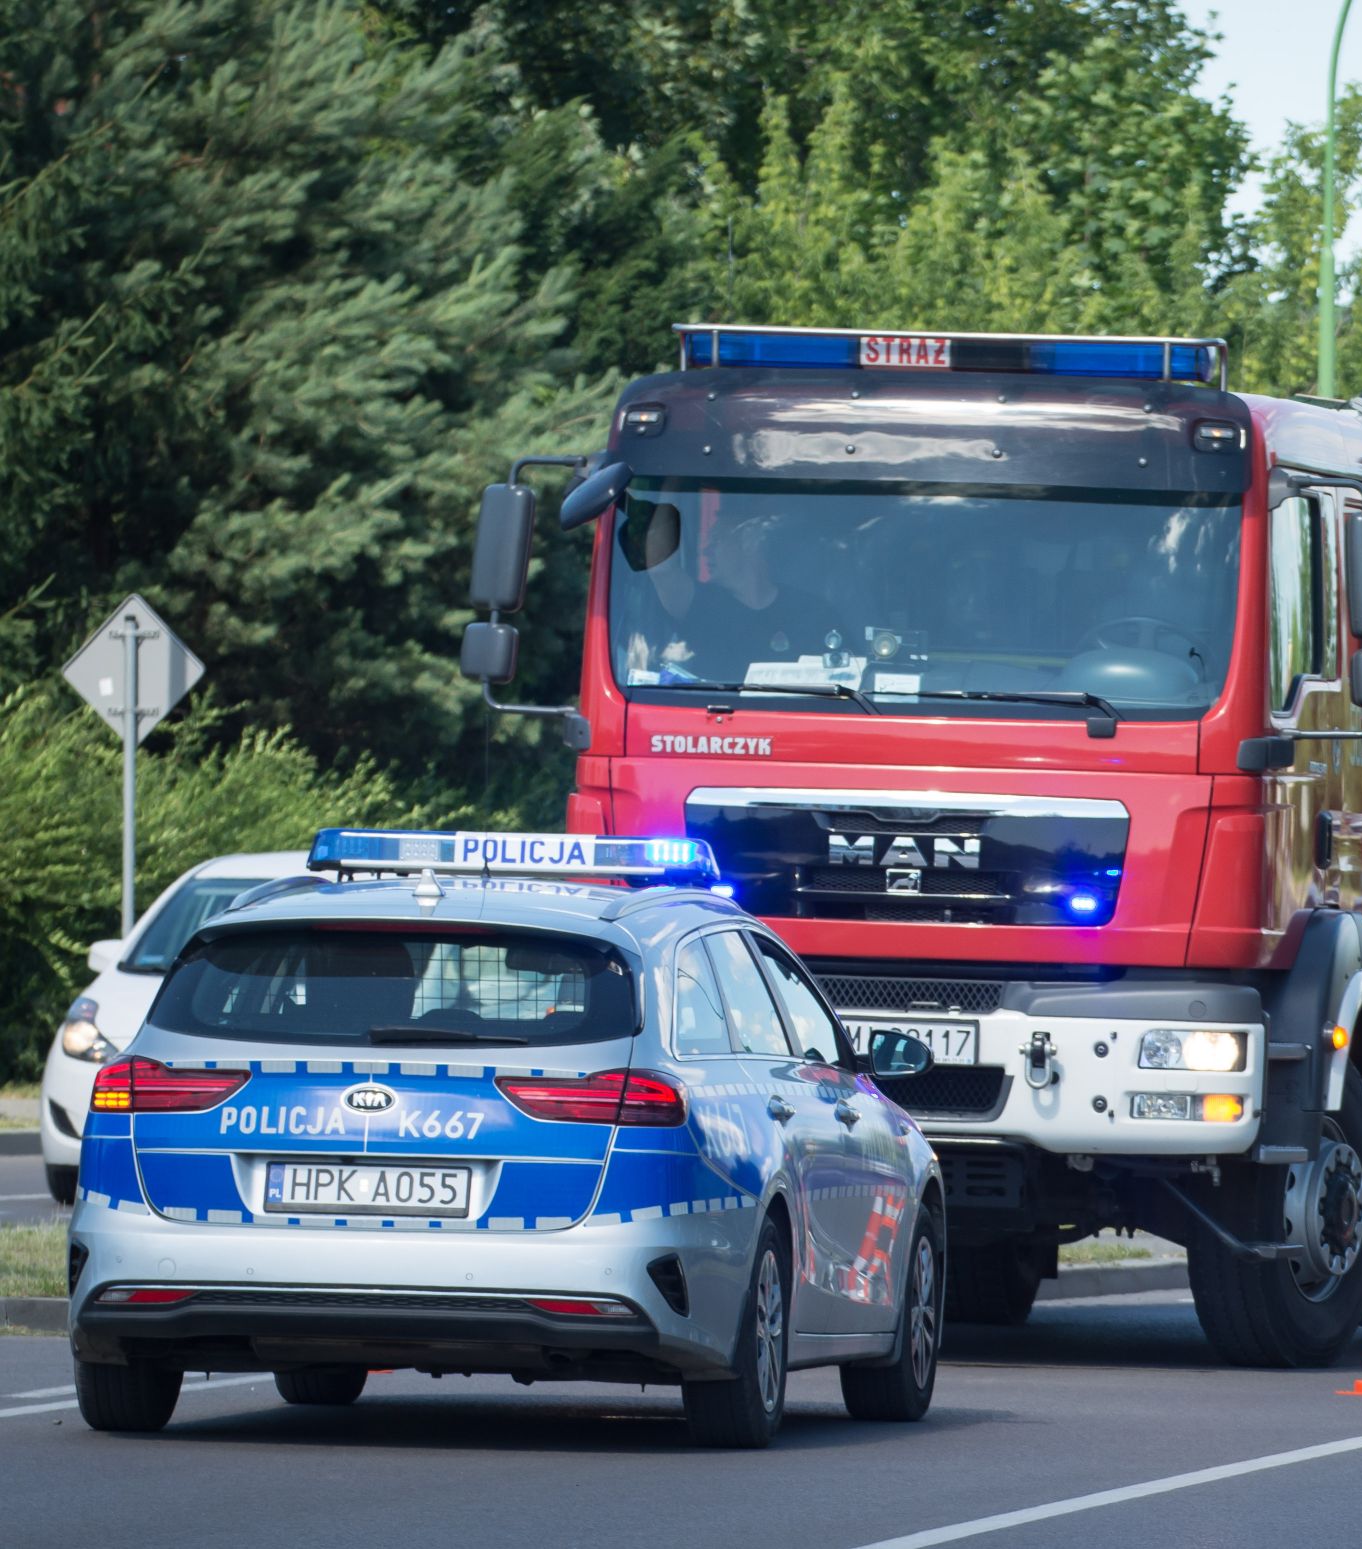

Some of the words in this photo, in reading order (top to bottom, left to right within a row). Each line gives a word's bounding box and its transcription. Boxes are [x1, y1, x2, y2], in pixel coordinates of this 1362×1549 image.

[651, 735, 772, 755] STOLARCZYK
[463, 838, 586, 865] POLICJA
[829, 835, 981, 869] MAN
[890, 1026, 972, 1057] 117
[352, 1091, 387, 1107] KIA
[219, 1106, 346, 1135] POLICJA
[398, 1109, 485, 1140] K667
[269, 1189, 282, 1199] PL
[290, 1167, 358, 1202] HPK
[371, 1169, 458, 1205] A055
